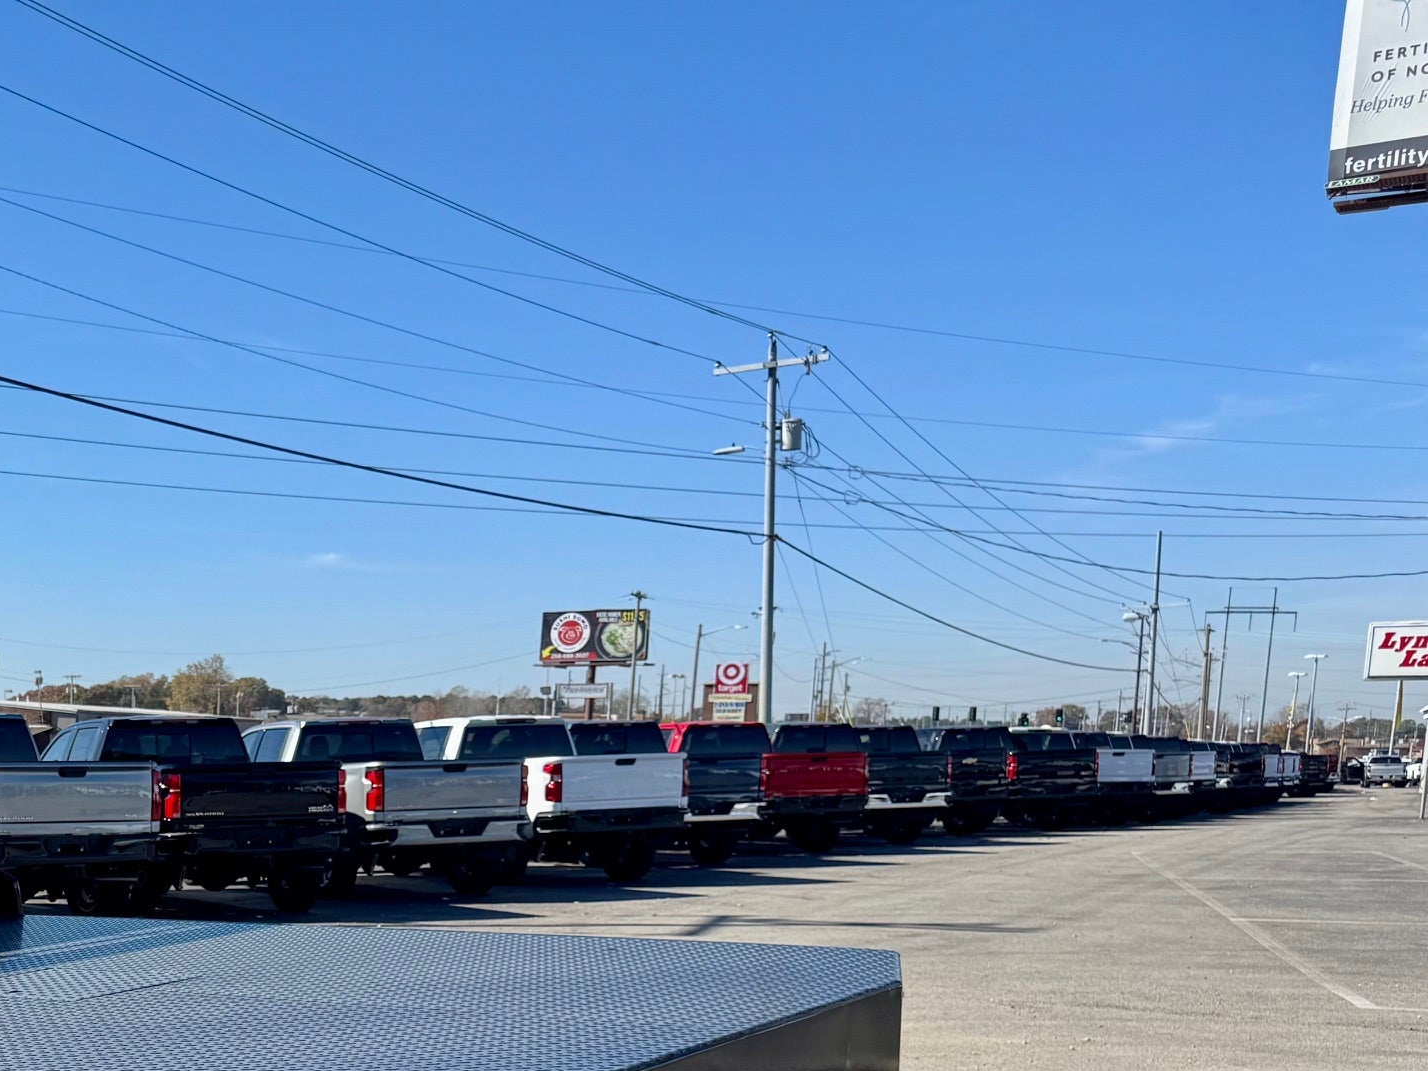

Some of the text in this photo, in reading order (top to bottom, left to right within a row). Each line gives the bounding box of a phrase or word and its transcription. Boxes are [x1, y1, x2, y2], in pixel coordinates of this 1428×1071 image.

[1373, 42, 1428, 63] FERTI
[1371, 68, 1397, 83] OF
[1350, 94, 1414, 113] Helping
[1327, 175, 1375, 189] LAMAR
[553, 615, 571, 631] SUSHI
[1399, 650, 1428, 668] La
[717, 683, 743, 694] target
